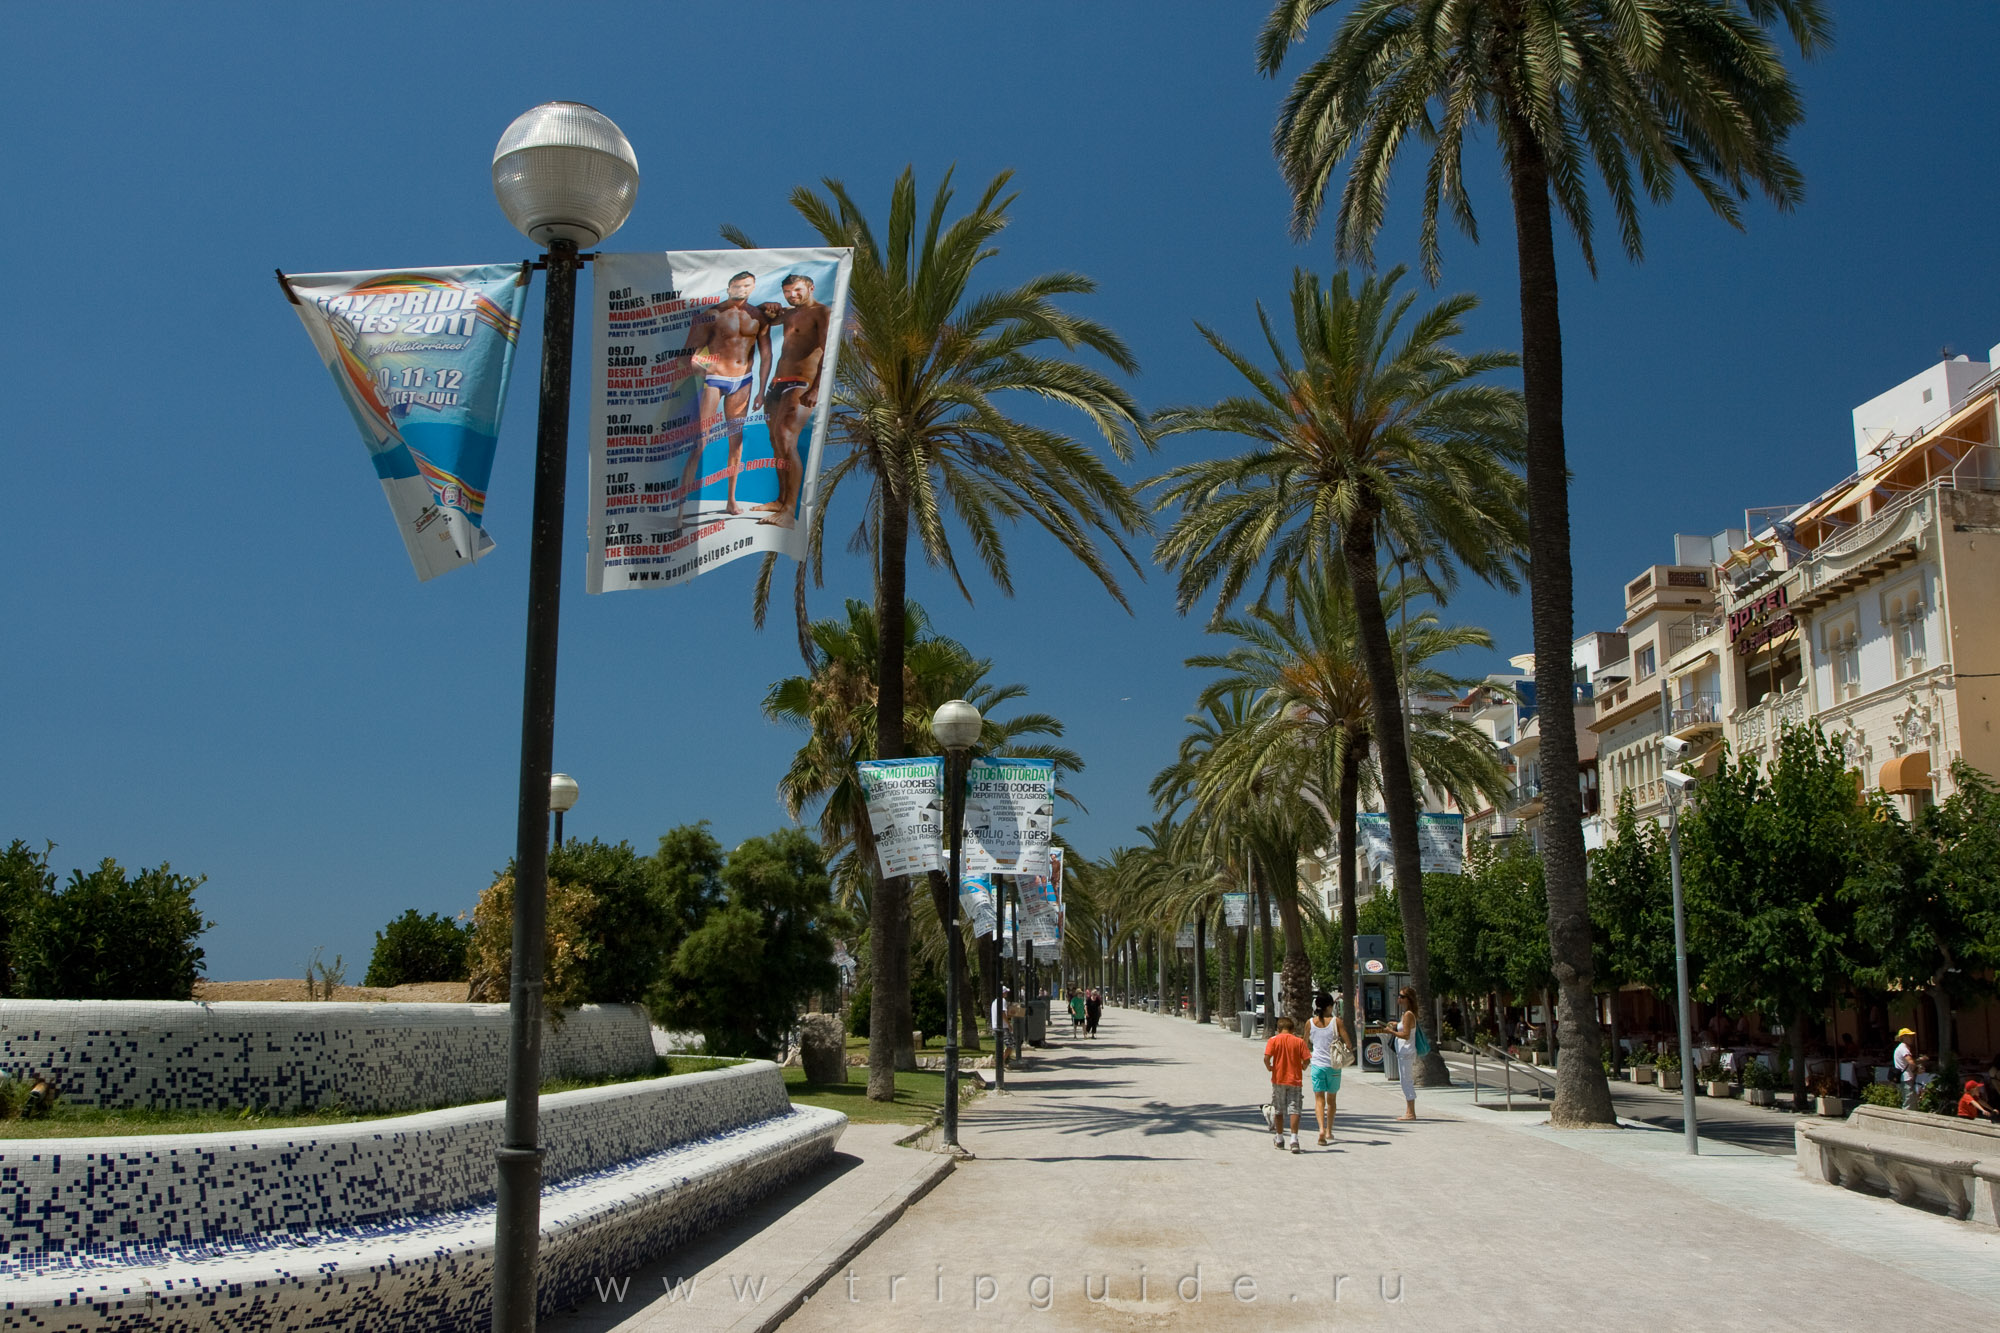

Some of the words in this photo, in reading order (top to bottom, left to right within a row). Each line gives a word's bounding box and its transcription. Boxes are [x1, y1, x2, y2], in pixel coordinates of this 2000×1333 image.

[609, 287, 632, 300] 08.07
[609, 297, 645, 310] VIERNES
[652, 290, 682, 304] FRIDAY
[316, 295, 376, 318] GAY
[379, 288, 482, 314] PRIDE
[608, 306, 652, 322] MADONNA
[653, 300, 686, 317] TRIBUTE
[690, 296, 720, 308] 21.00H
[404, 312, 477, 336] 2011
[608, 346, 634, 356] 09.07
[656, 347, 698, 363] SATURDAY
[608, 368, 643, 378] DESFILE
[651, 360, 679, 376] PARADE
[402, 367, 425, 387] 11
[436, 369, 463, 389] 12
[608, 380, 633, 388] DANA
[428, 392, 458, 406] JULI
[633, 388, 654, 396] SITGES
[607, 414, 632, 424] 10.07
[607, 424, 653, 436] DOMINGO
[662, 415, 690, 432] SUNDAY
[606, 436, 648, 448] MICHAEL
[650, 430, 685, 446] JACKSON
[686, 412, 723, 435] EXPERIENCE
[606, 448, 635, 456] CARRERA
[619, 456, 644, 464] SUNDAY
[644, 452, 671, 463] CABARET
[606, 472, 628, 484] 11.07
[606, 494, 638, 508] JUNGLE
[640, 492, 670, 504] PARTY
[688, 478, 704, 492] LADY
[704, 464, 737, 487] DIAMOND
[746, 458, 776, 471] ROUTE
[776, 458, 792, 470] 66
[606, 484, 636, 496] LUNES
[644, 477, 679, 492] MONDAY
[606, 507, 625, 516] PARTY
[661, 503, 672, 512] GAY
[606, 523, 630, 536] 12.07
[605, 547, 622, 558] THE
[624, 545, 660, 556] GEORGE
[662, 537, 690, 554] MICHAEL
[690, 518, 726, 544] EXPERIENCE
[606, 534, 642, 547] MARTES
[650, 527, 683, 544] TUESDAY
[604, 559, 622, 567] PRIDE
[624, 557, 651, 566] CLOSING
[629, 536, 754, 581] www.gaypridesitges.com
[1729, 586, 1788, 643] HOTEL
[884, 780, 898, 790] 150
[900, 779, 936, 788] COCHES
[994, 783, 1010, 792] 150
[1010, 783, 1046, 792] COCHES
[880, 832, 886, 840] 3
[968, 830, 974, 838] 3
[977, 830, 1004, 839] JULIO
